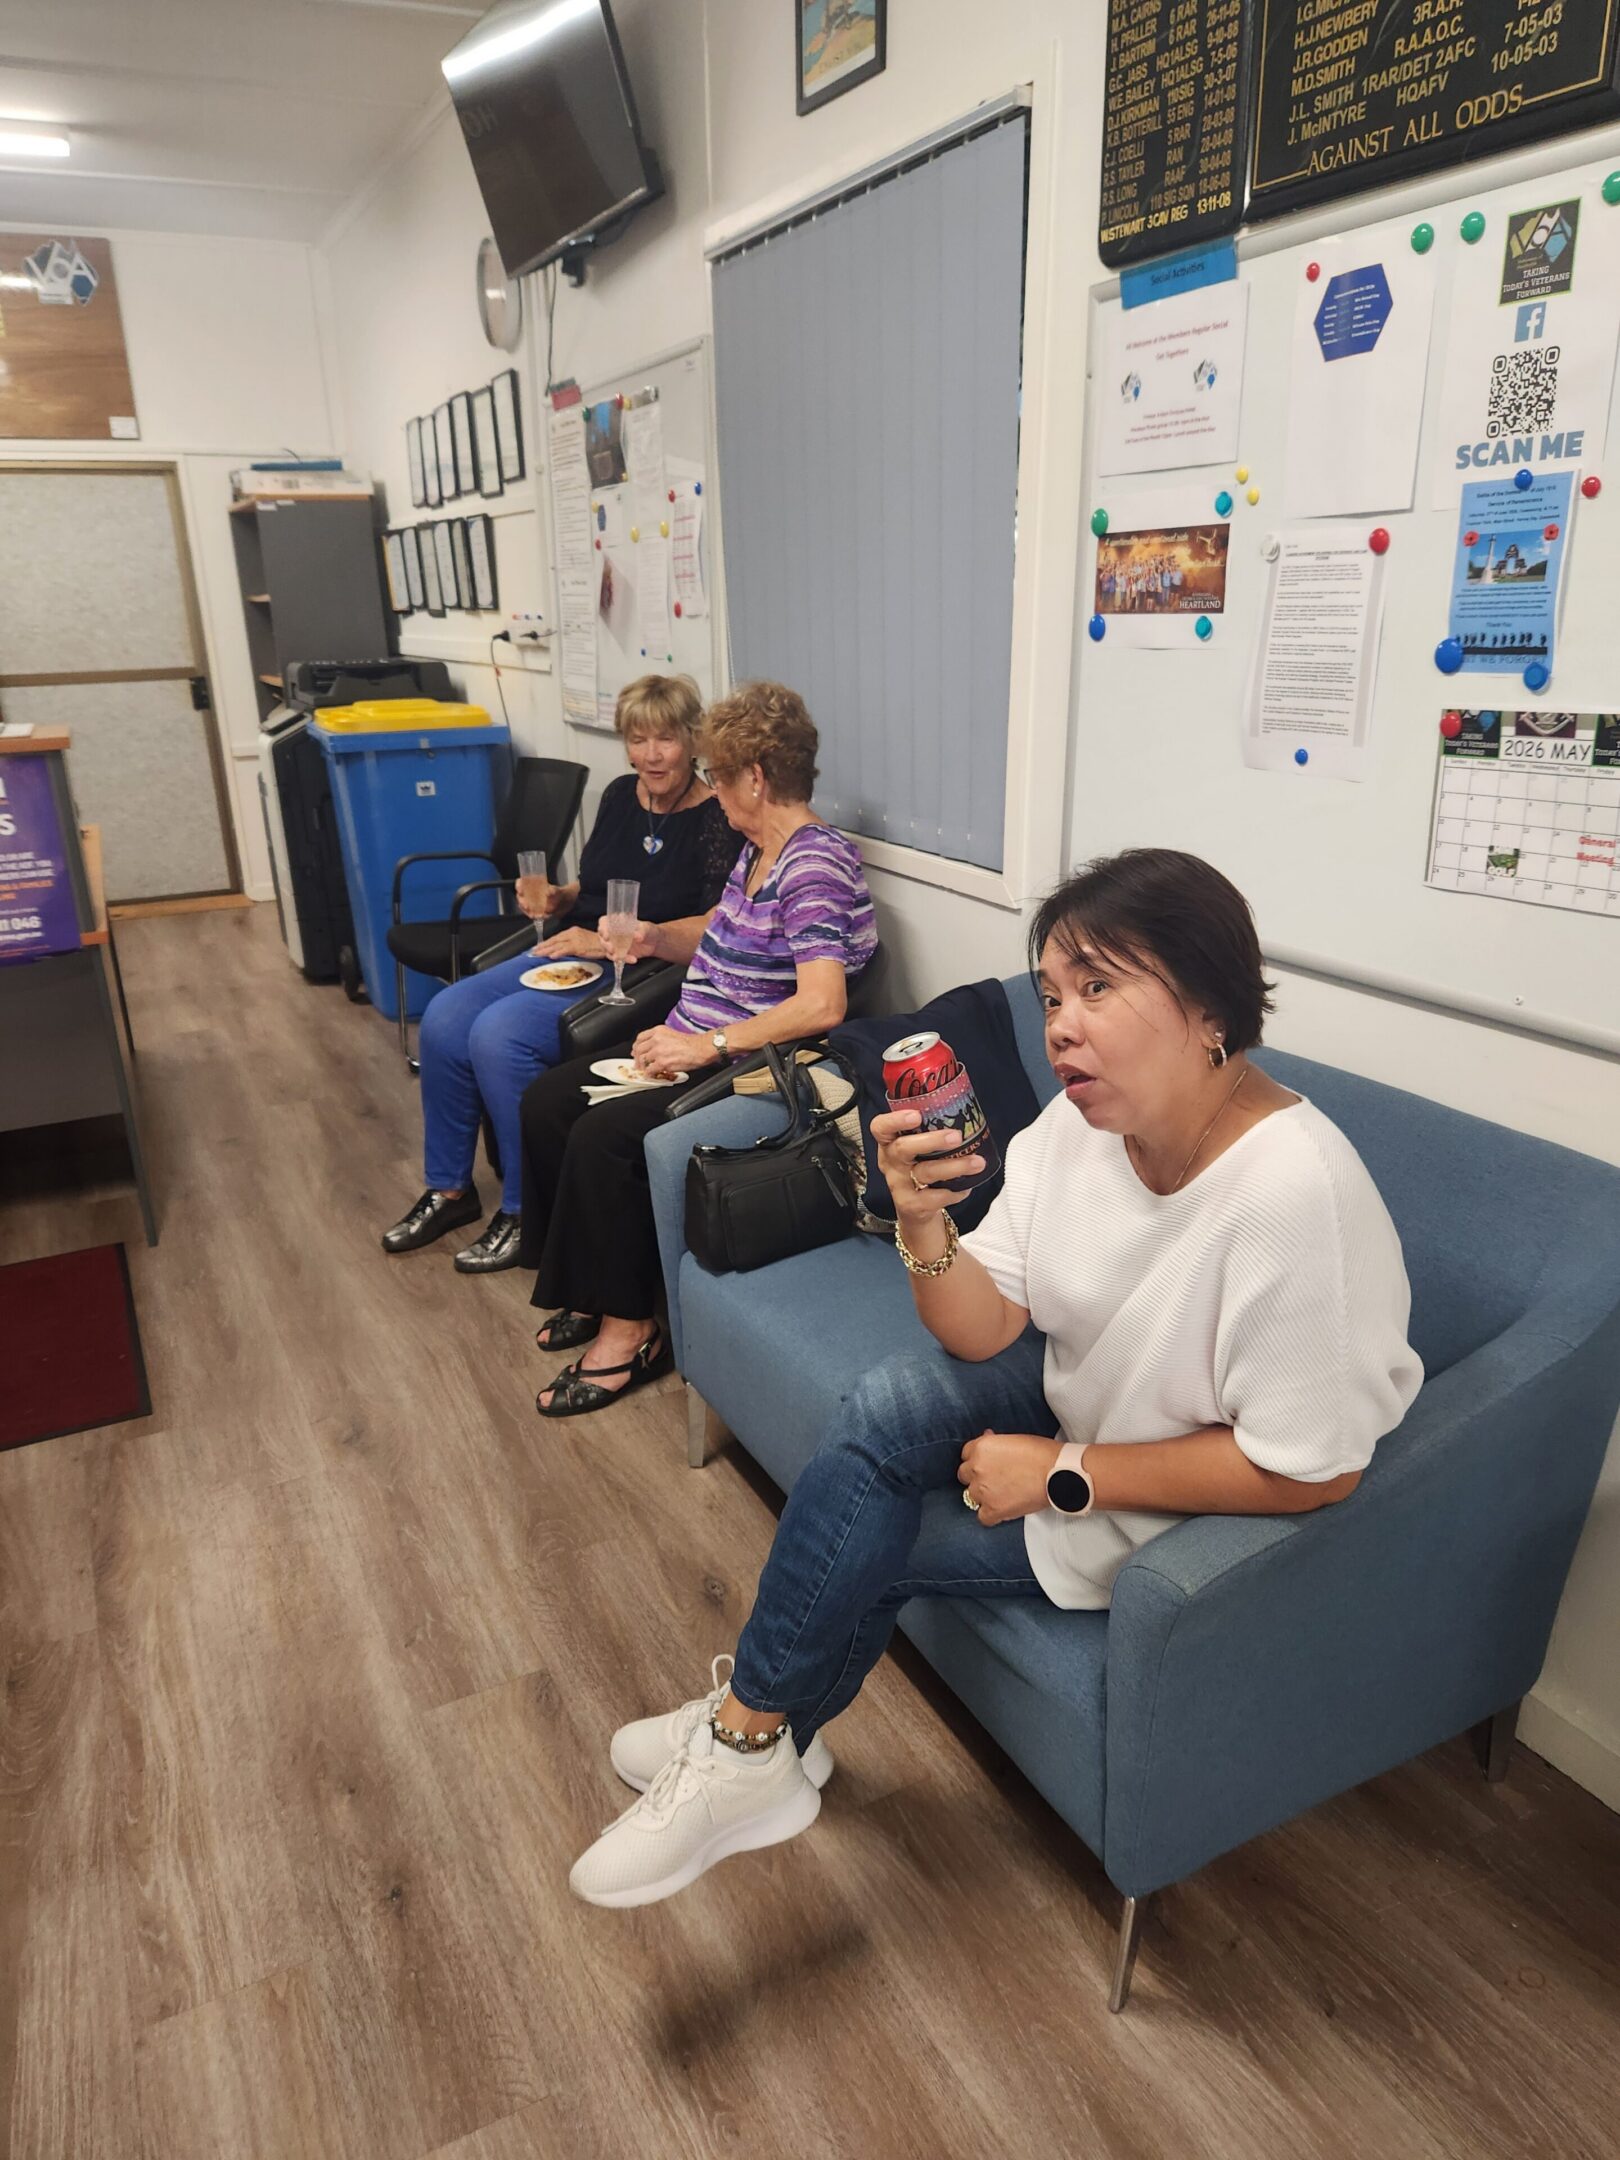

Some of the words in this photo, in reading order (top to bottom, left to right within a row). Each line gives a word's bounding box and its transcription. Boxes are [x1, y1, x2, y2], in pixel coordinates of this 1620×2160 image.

[1176, 1, 1198, 22] RAR
[1176, 18, 1197, 42] RAR
[1289, 102, 1311, 124] J.L.
[1313, 82, 1355, 114] SMITH
[1435, 36, 1476, 70] 2AFC
[1504, 4, 1563, 44] 7-05-03
[1290, 56, 1356, 97] M.D.SMITH
[1393, 14, 1465, 59] R.A.A.O.C.
[1125, 77, 1156, 105] BAILEY
[1301, 101, 1368, 141] McINTYRE
[1395, 71, 1450, 108] HQAFV
[1490, 31, 1559, 74] 10-05-03
[1173, 122, 1192, 143] RAR
[1307, 126, 1395, 176] AGAINST
[1403, 111, 1444, 147] ALL
[1455, 84, 1524, 130] ODDS
[1166, 145, 1184, 166] RAN
[1116, 182, 1138, 203] LONG
[1170, 203, 1189, 224] REG
[1151, 271, 1172, 285] Social
[1172, 261, 1205, 280] Activities
[1455, 436, 1534, 470] SCAN
[1539, 430, 1585, 461] ME
[1179, 599, 1221, 609] HEARTLAND
[1504, 739, 1545, 759] 2026
[1550, 743, 1592, 761] MAY
[1579, 836, 1616, 848] General
[1576, 852, 1614, 867] Meeting
